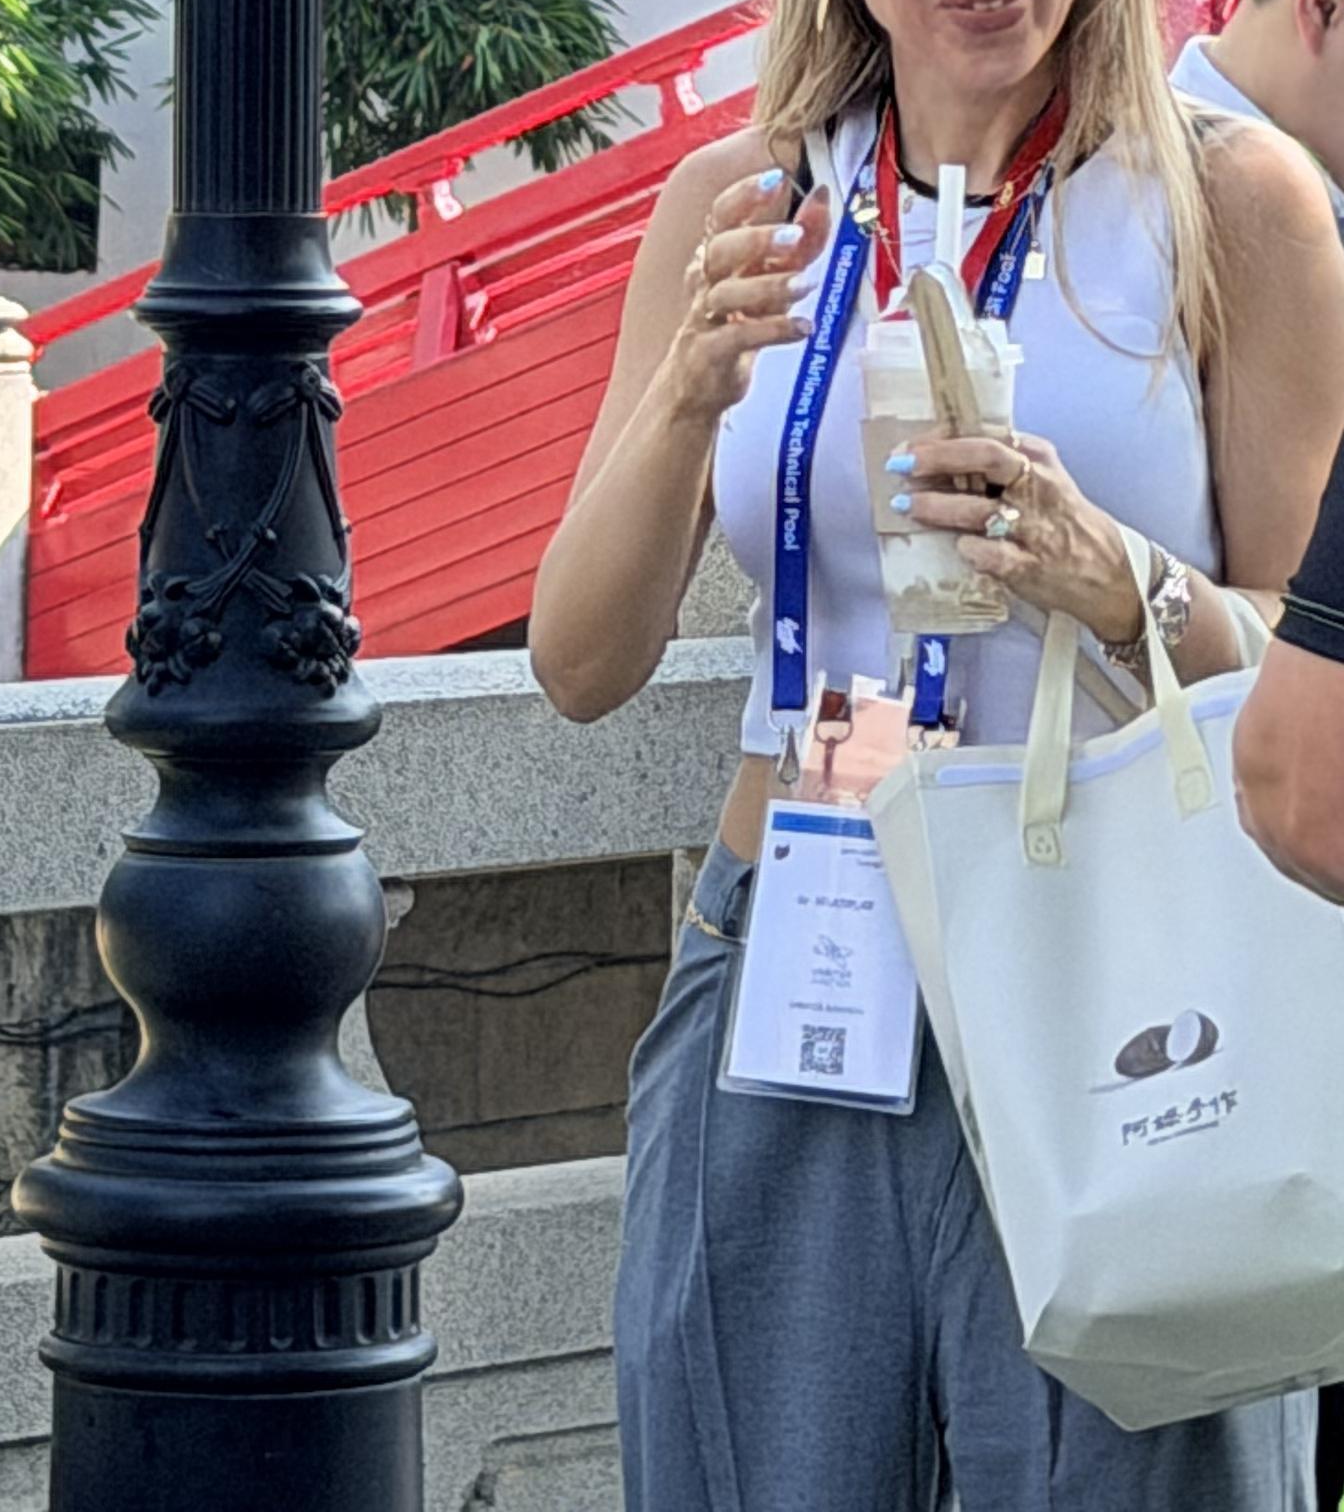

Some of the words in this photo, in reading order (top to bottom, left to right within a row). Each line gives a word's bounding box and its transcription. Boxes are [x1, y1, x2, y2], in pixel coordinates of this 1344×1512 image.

[813, 244, 858, 350] International
[794, 352, 827, 416] Airlines
[783, 417, 811, 504] Technical
[783, 506, 801, 551] Pool
